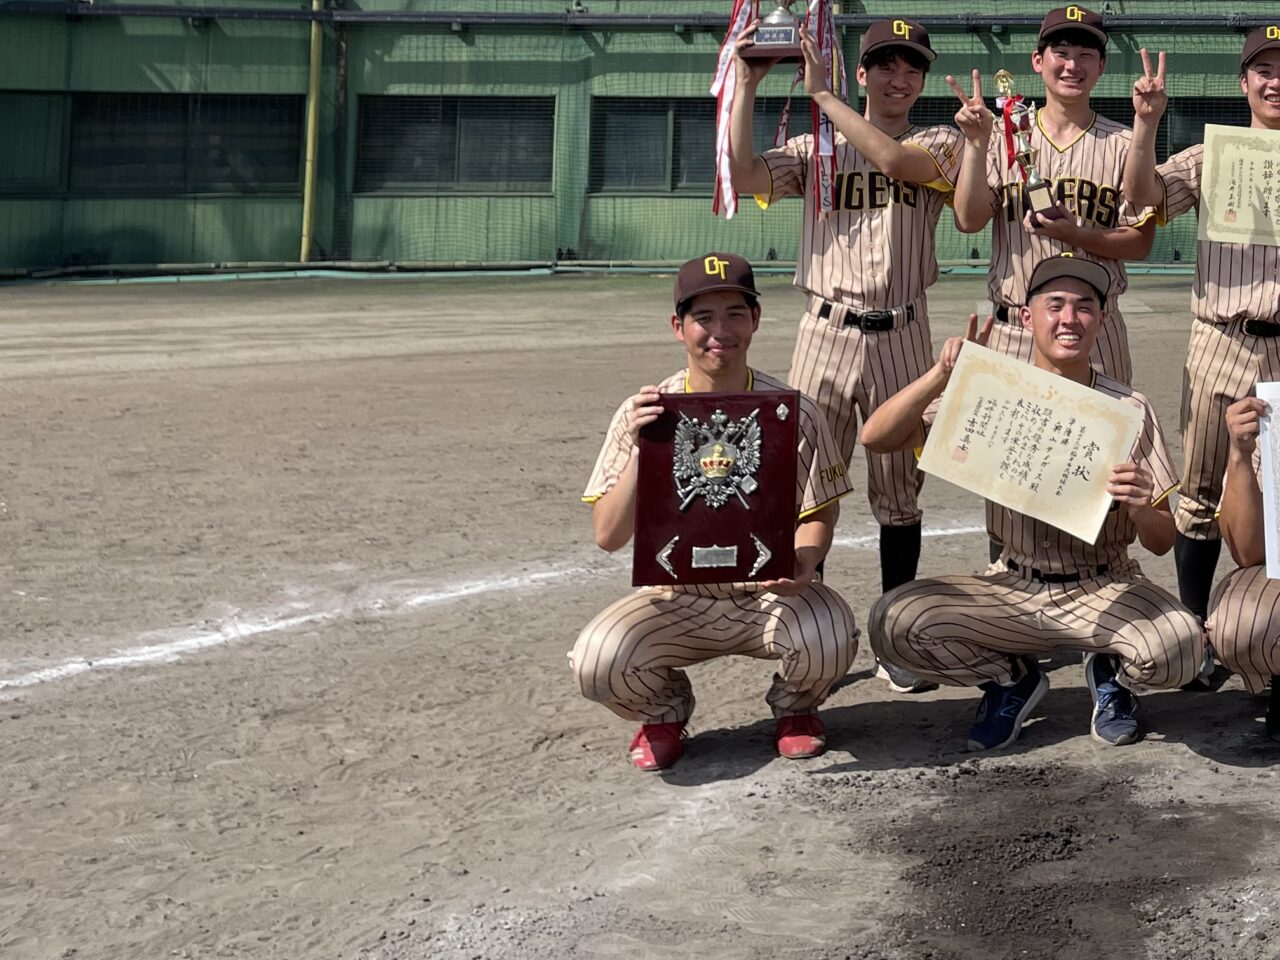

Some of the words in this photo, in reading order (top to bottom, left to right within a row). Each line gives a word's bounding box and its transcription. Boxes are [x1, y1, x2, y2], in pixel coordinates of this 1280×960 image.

[835, 170, 918, 211] IGERS
[1000, 177, 1118, 228] TERS
[1071, 440, 1100, 482] 賞状
